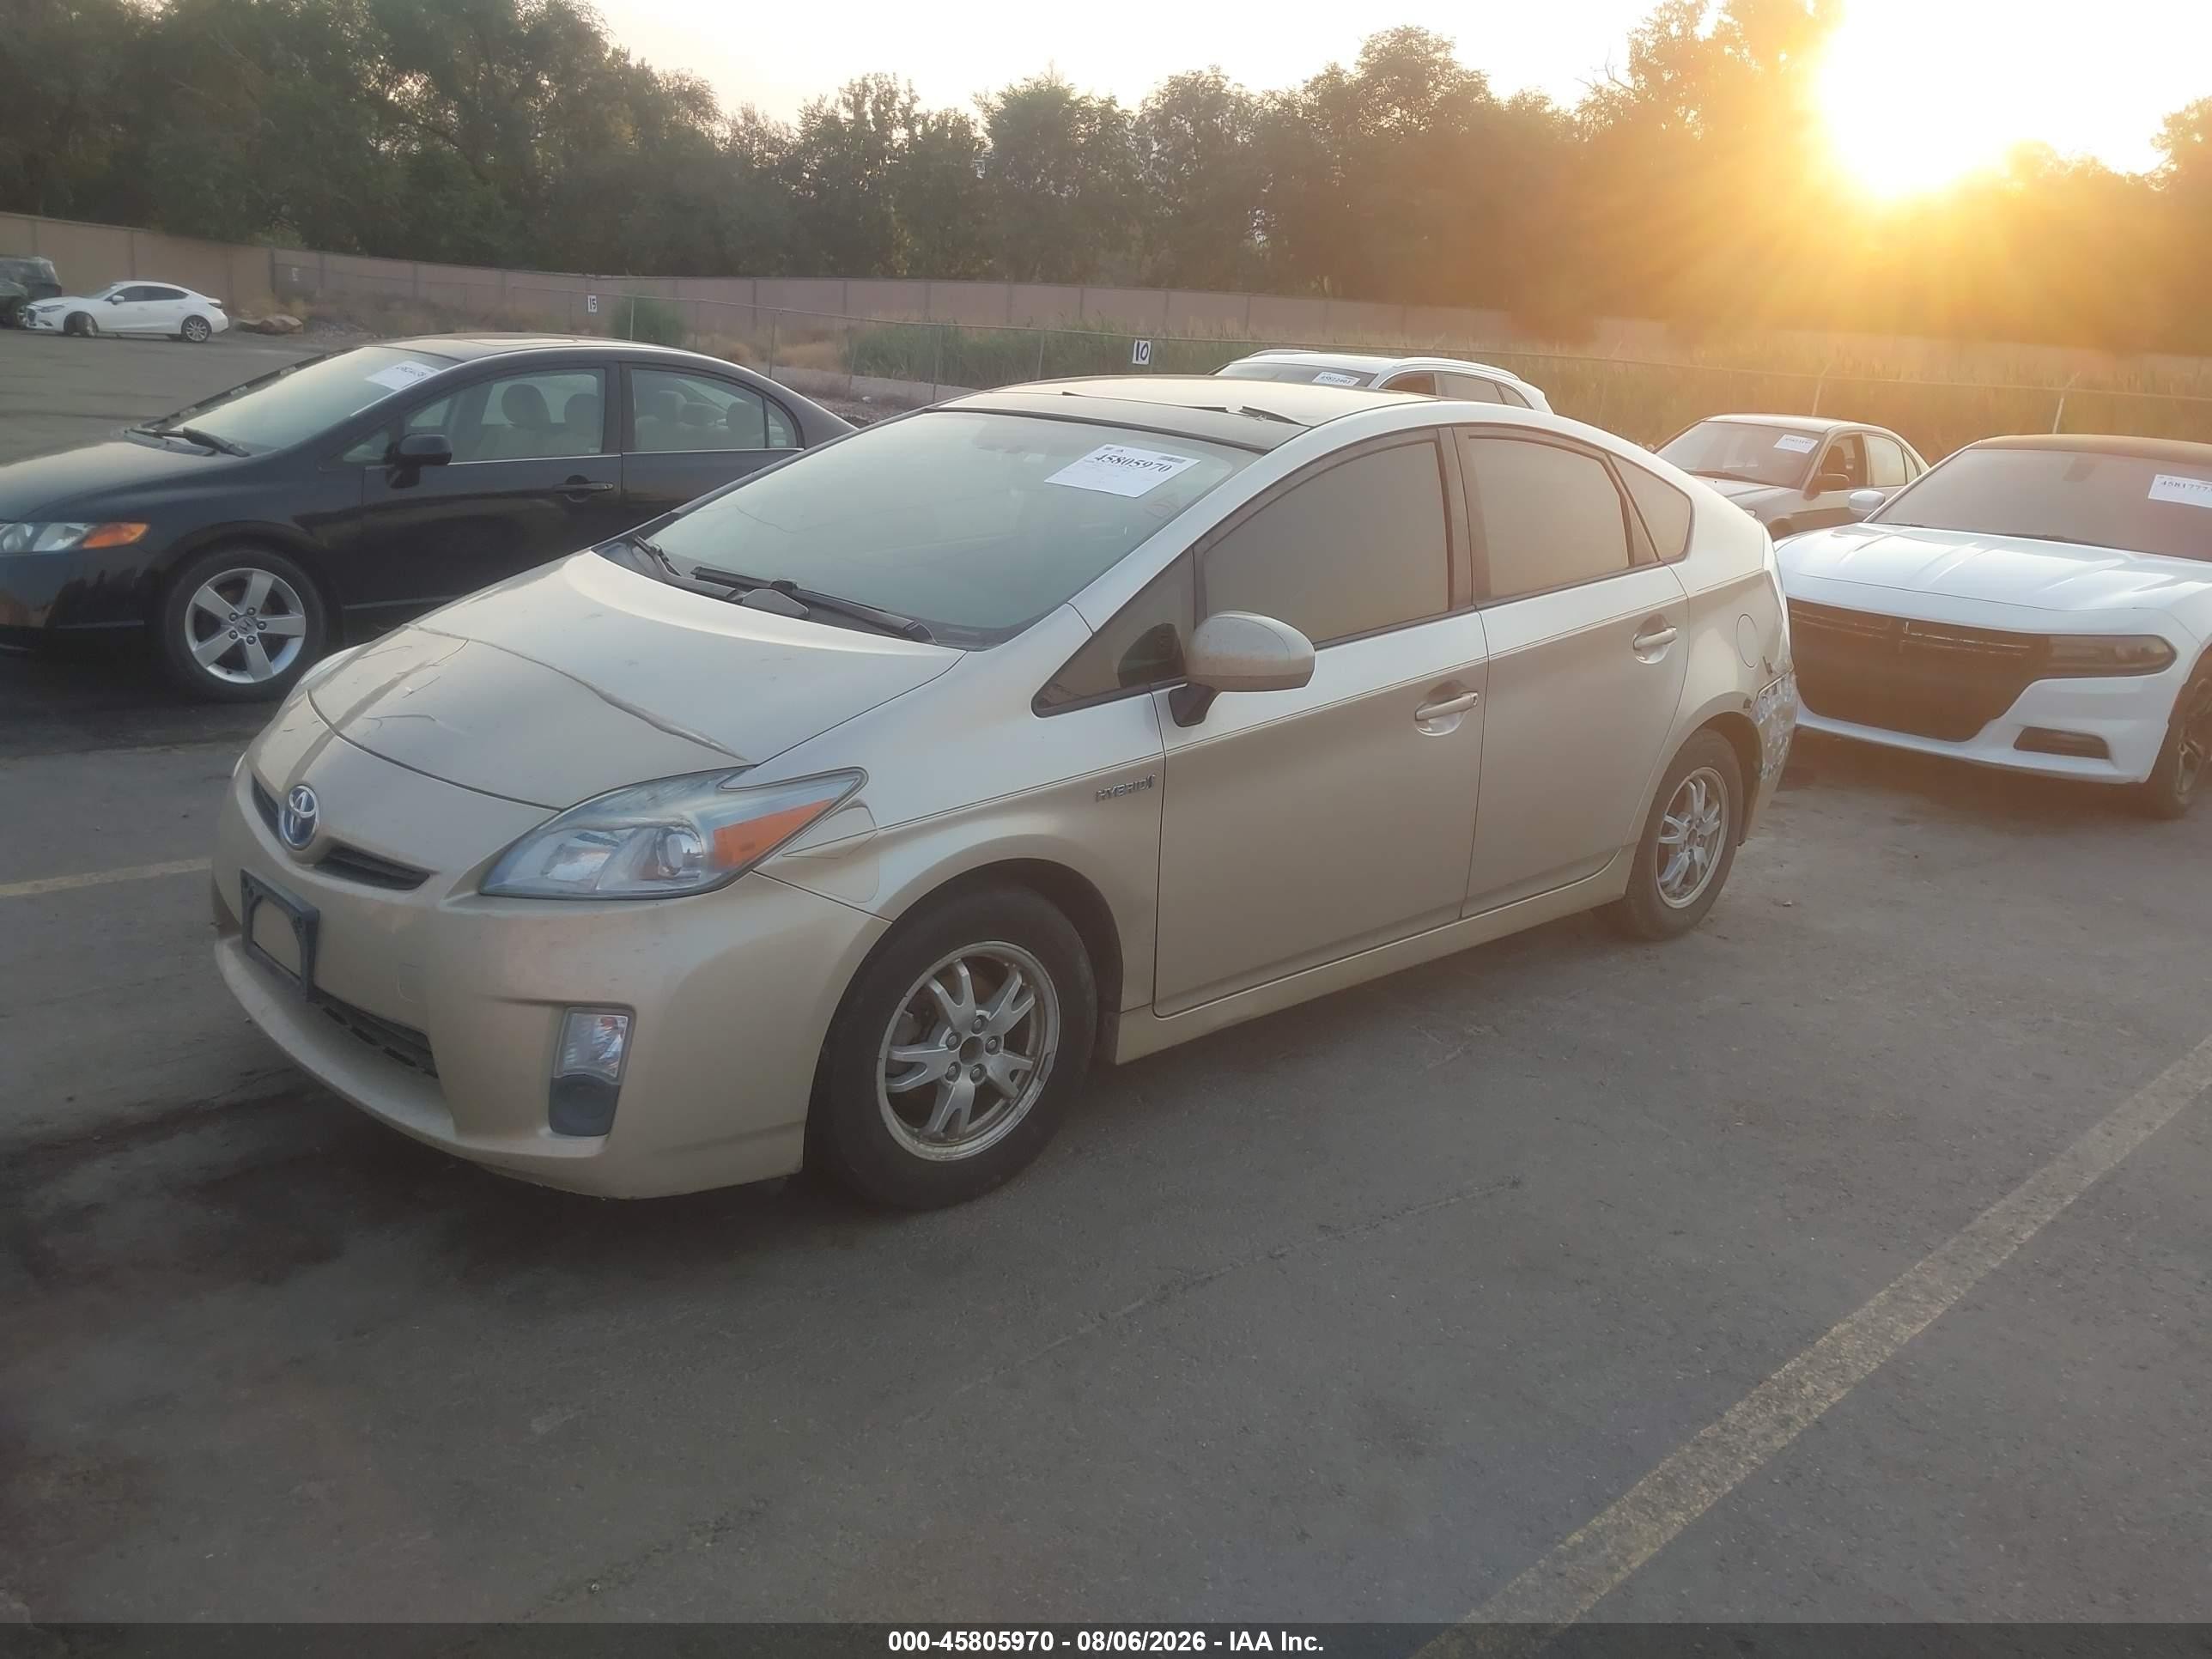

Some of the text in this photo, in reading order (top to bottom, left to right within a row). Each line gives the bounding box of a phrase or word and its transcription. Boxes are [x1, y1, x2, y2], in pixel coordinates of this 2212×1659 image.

[589, 296, 597, 310] 15
[1135, 341, 1149, 362] 10
[1094, 453, 1174, 473] 45805970
[1095, 775, 1156, 802] HYBRID
